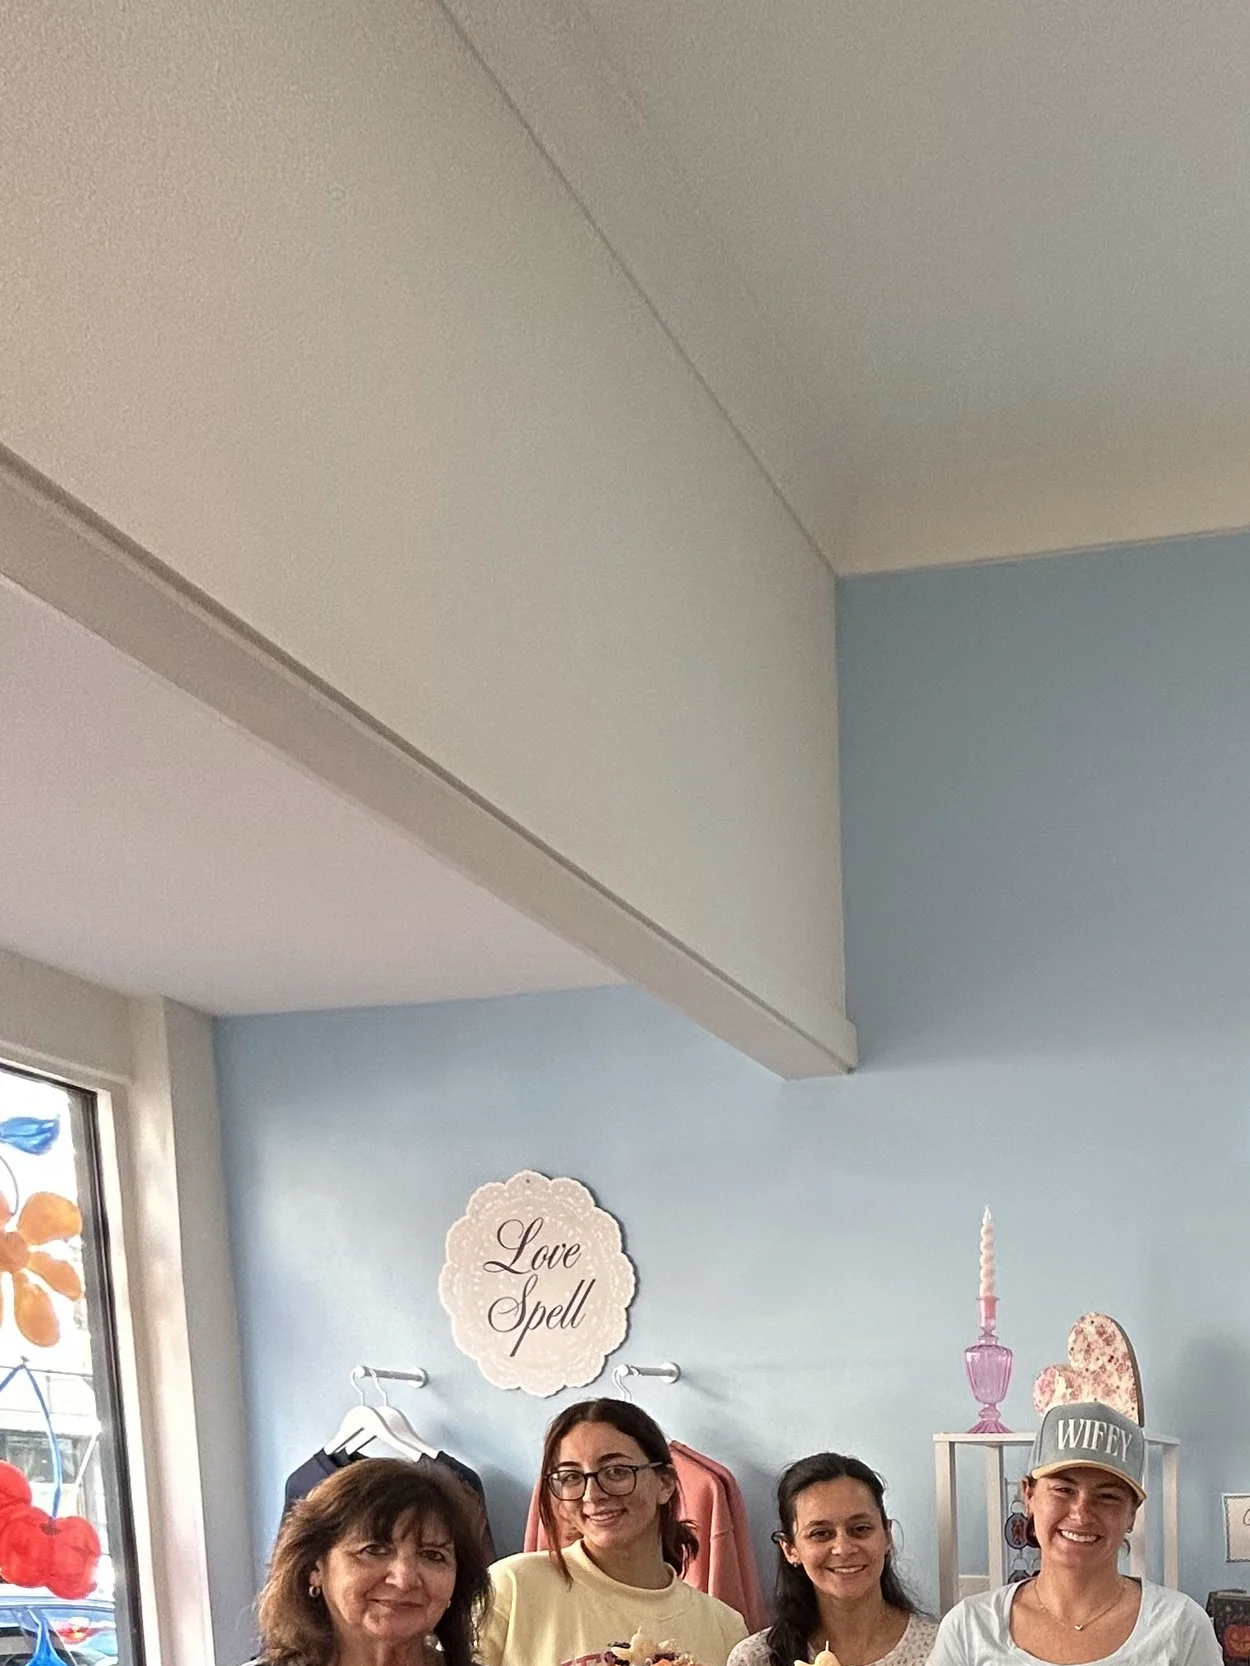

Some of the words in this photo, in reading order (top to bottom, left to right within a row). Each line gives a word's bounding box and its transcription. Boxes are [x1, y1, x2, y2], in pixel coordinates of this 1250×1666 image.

[483, 1217, 581, 1275] Love
[488, 1274, 596, 1357] Spell
[1057, 1418, 1133, 1462] WIFEY
